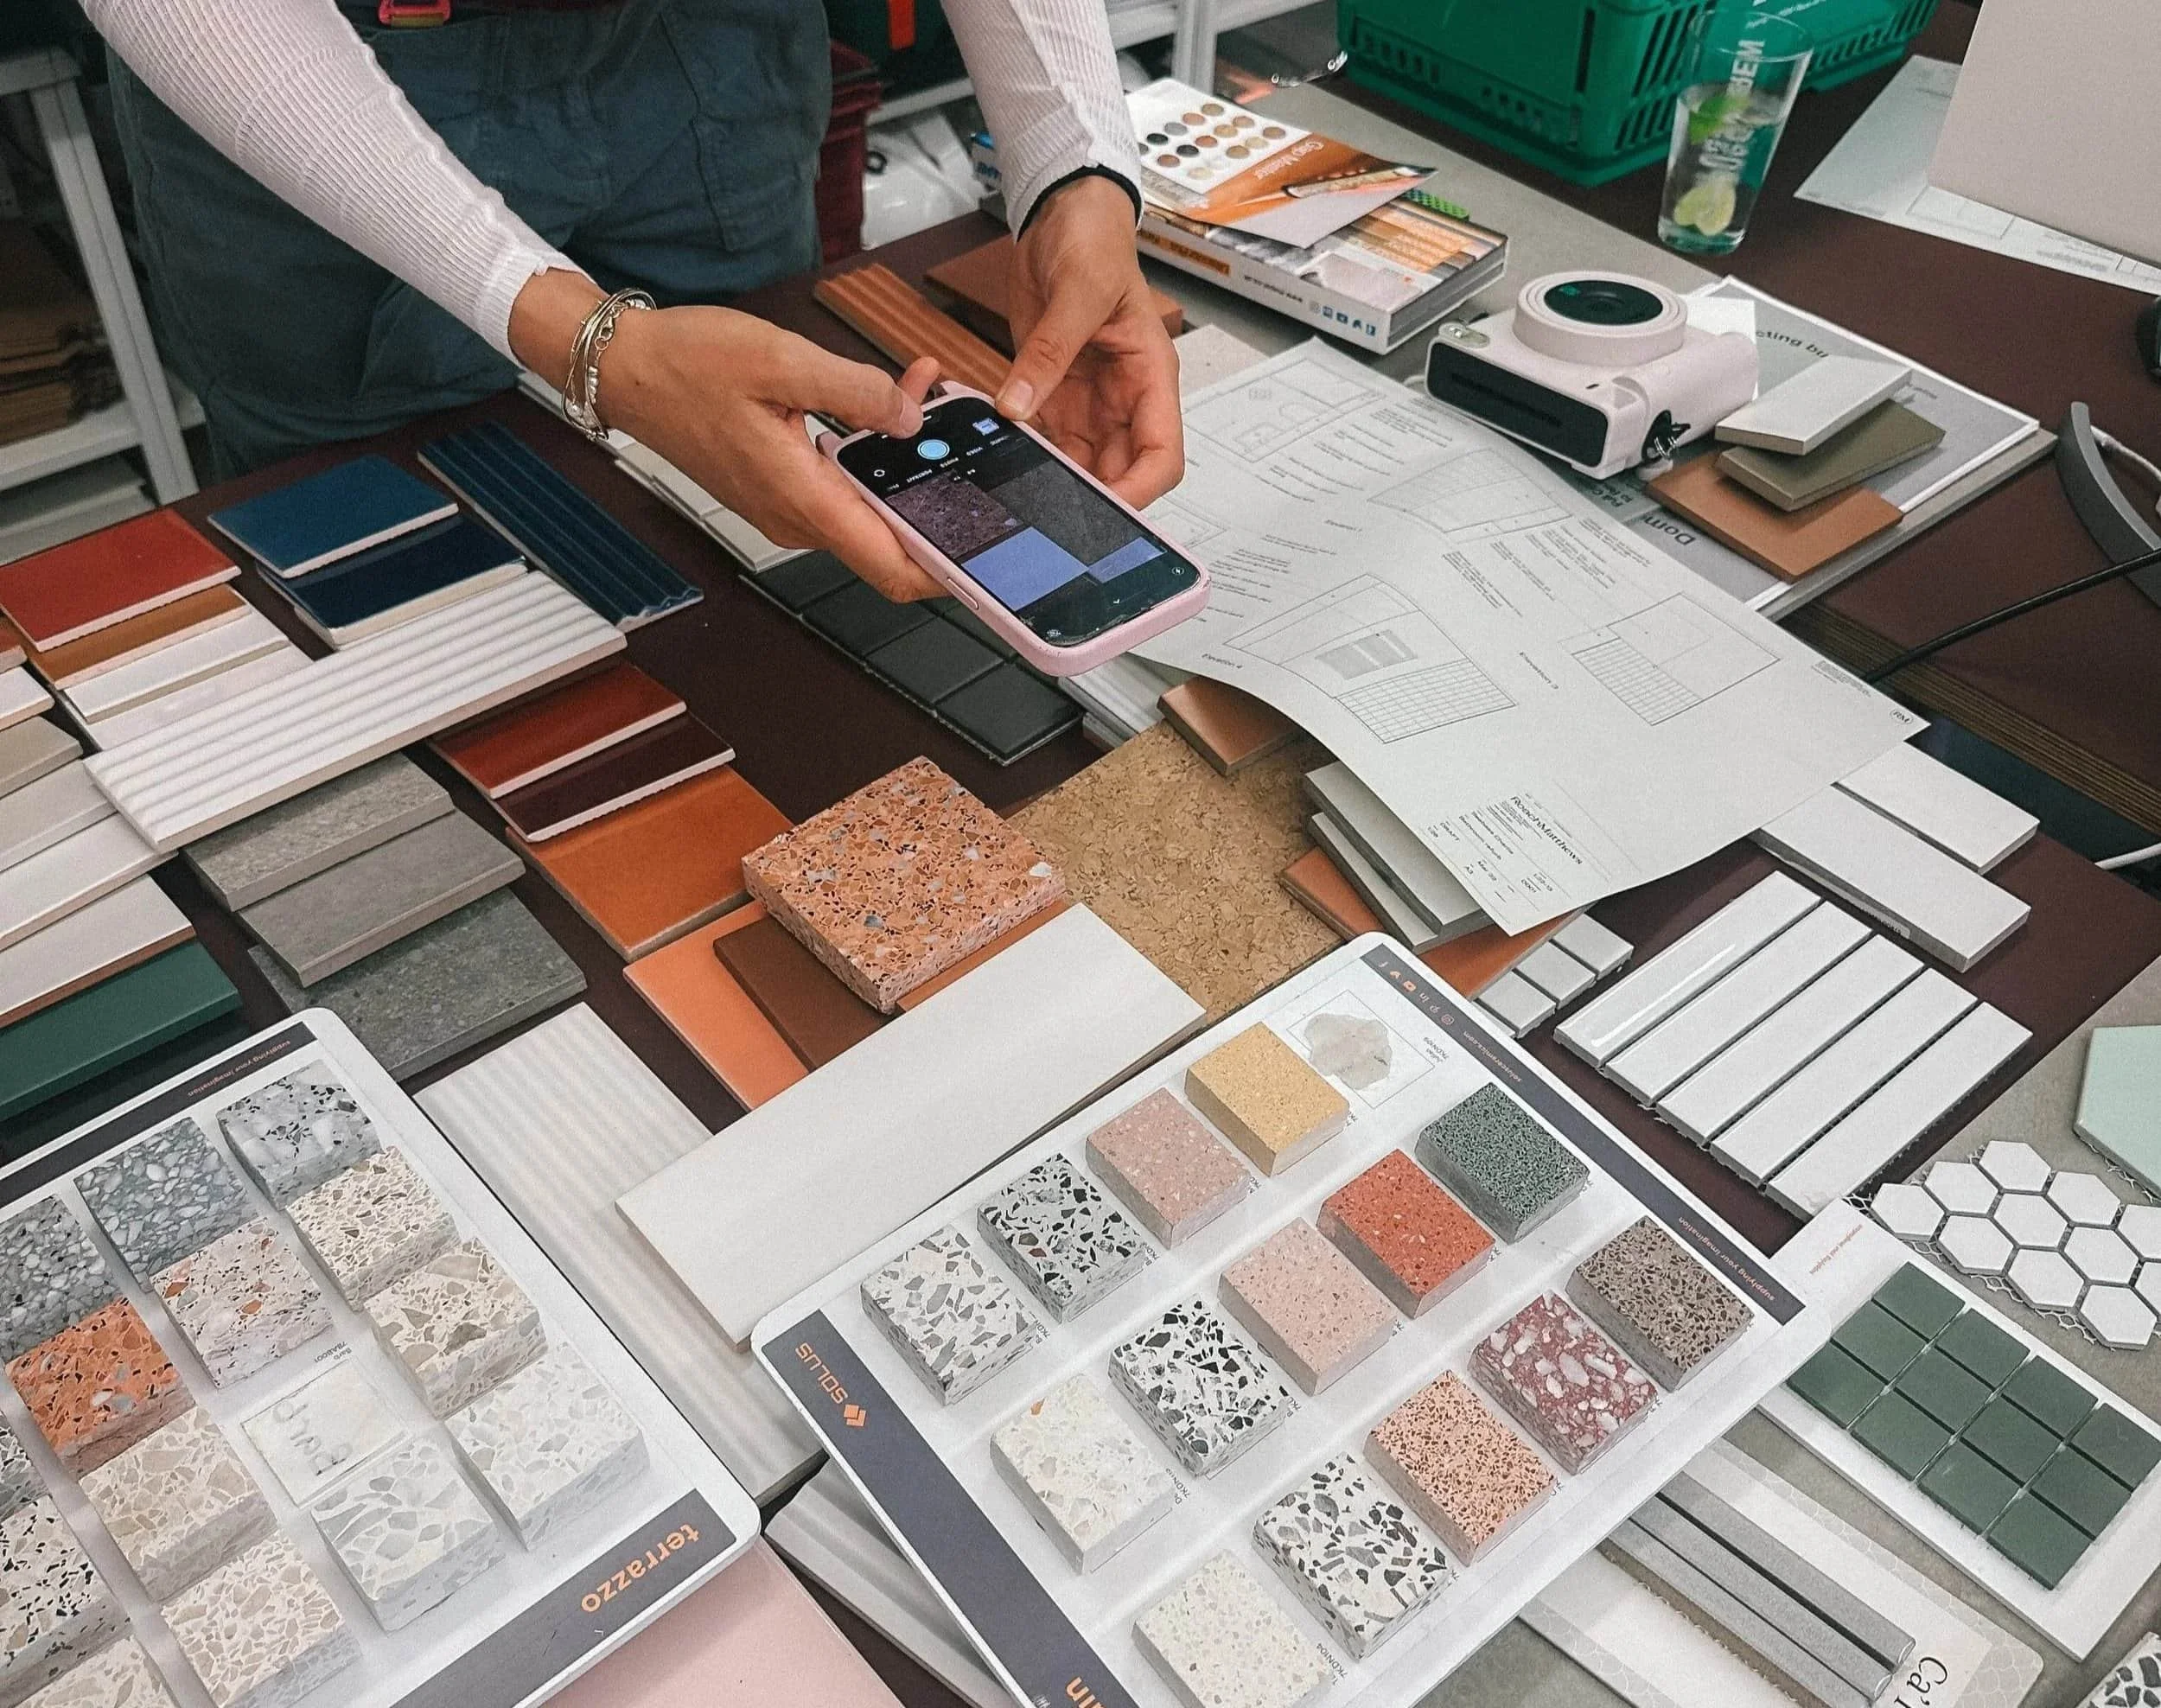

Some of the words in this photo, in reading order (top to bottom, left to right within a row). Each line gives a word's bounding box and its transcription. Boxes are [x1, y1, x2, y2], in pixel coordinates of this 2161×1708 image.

[1640, 513, 1696, 545] Dom
[1510, 796, 1583, 864] RoachMatthews
[233, 1058, 253, 1073] your
[252, 1040, 290, 1062] supplying
[1463, 1030, 1523, 1082] solusceramics.com
[188, 1069, 234, 1096] imagination
[1678, 1217, 1720, 1254] imagination
[1718, 1252, 1740, 1271] your
[1737, 1267, 1775, 1301] supplying
[332, 1346, 352, 1361] Barb
[795, 1342, 848, 1404] SOLUS
[581, 1524, 699, 1612] terrazzo
